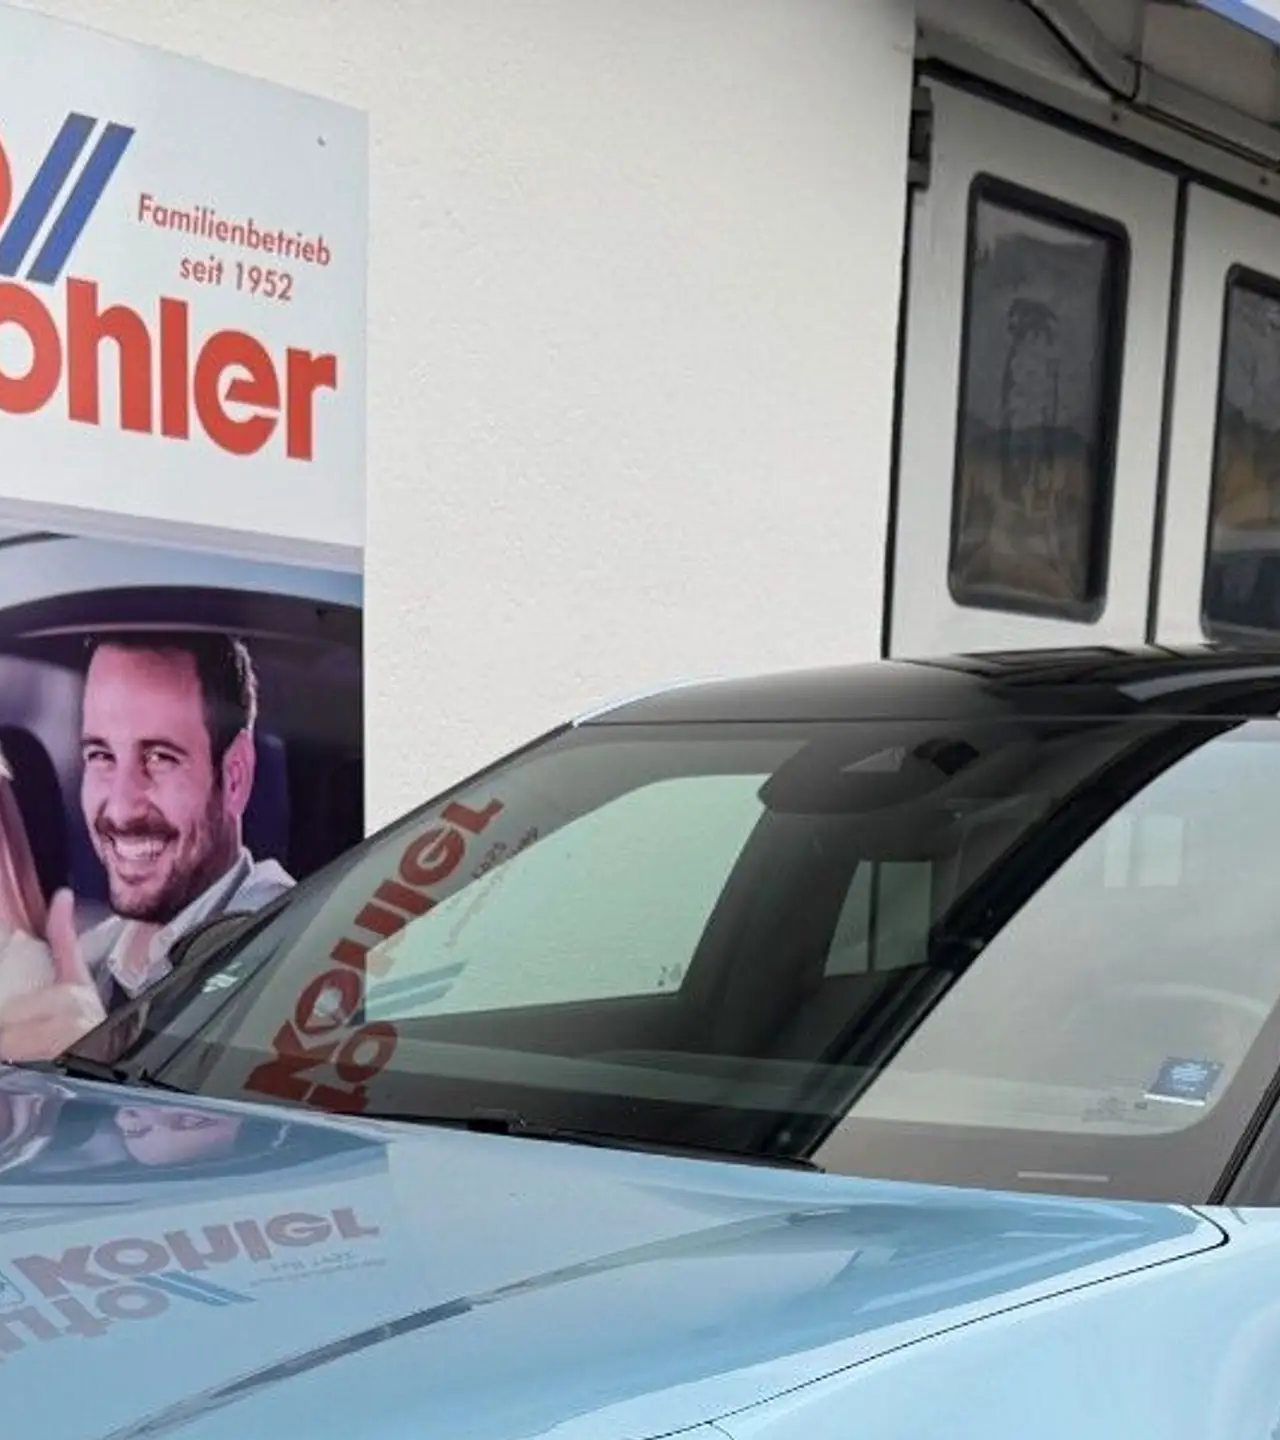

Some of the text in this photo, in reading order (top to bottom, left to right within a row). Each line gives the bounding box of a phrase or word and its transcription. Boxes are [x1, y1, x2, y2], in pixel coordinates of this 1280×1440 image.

[138, 194, 332, 267] Familienbetrieb
[180, 254, 294, 302] seit 1952
